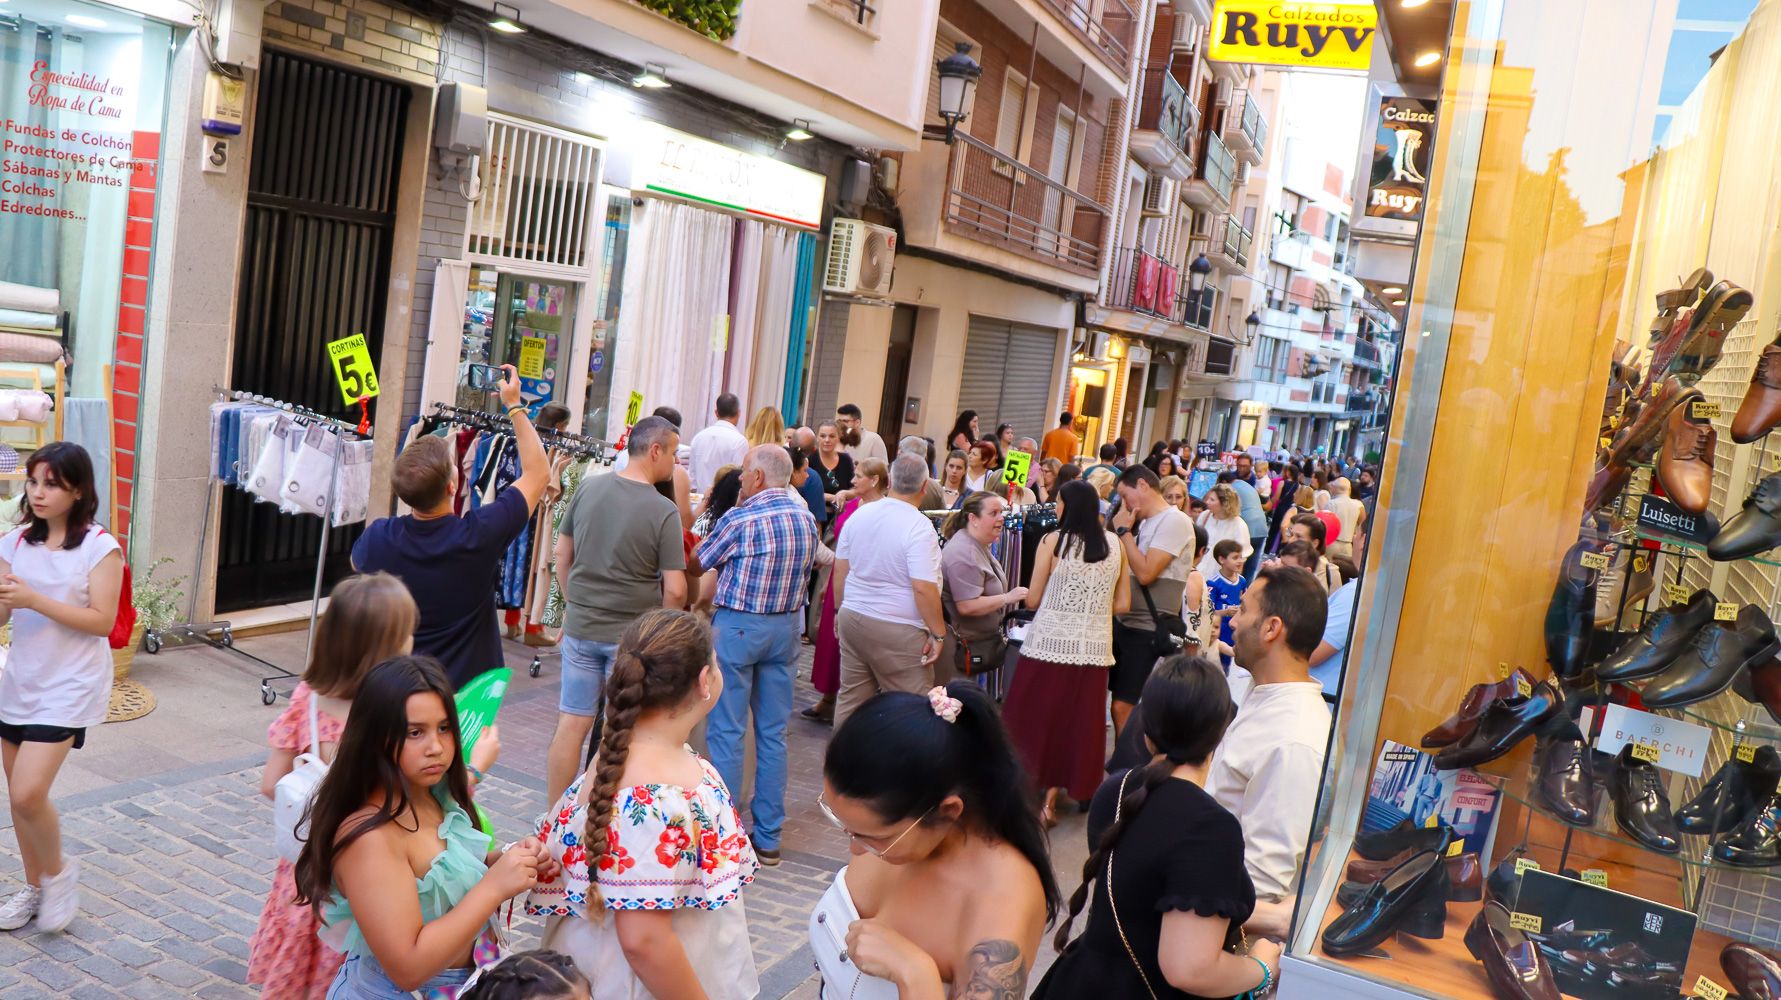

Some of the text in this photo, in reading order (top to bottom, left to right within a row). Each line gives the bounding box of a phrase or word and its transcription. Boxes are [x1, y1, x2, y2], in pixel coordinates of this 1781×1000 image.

[1269, 5, 1364, 23] Calzados
[30, 60, 124, 96] Especialidad en
[28, 84, 122, 119] Ropa de Cama
[5, 120, 132, 151] Fundas de Colchón
[4, 139, 144, 171] Protectores de Cama
[210, 142, 226, 166] 5
[3, 160, 123, 187] Sábanas y Mantas
[1, 180, 56, 198] Colchas
[0, 200, 87, 221] Edredones...
[331, 337, 364, 354] CORTINAS
[1641, 502, 1696, 531] Luisetti
[1636, 744, 1658, 755] Ruyvi
[1514, 914, 1538, 923] Ruyvi
[1701, 979, 1722, 996] Ruyvi
